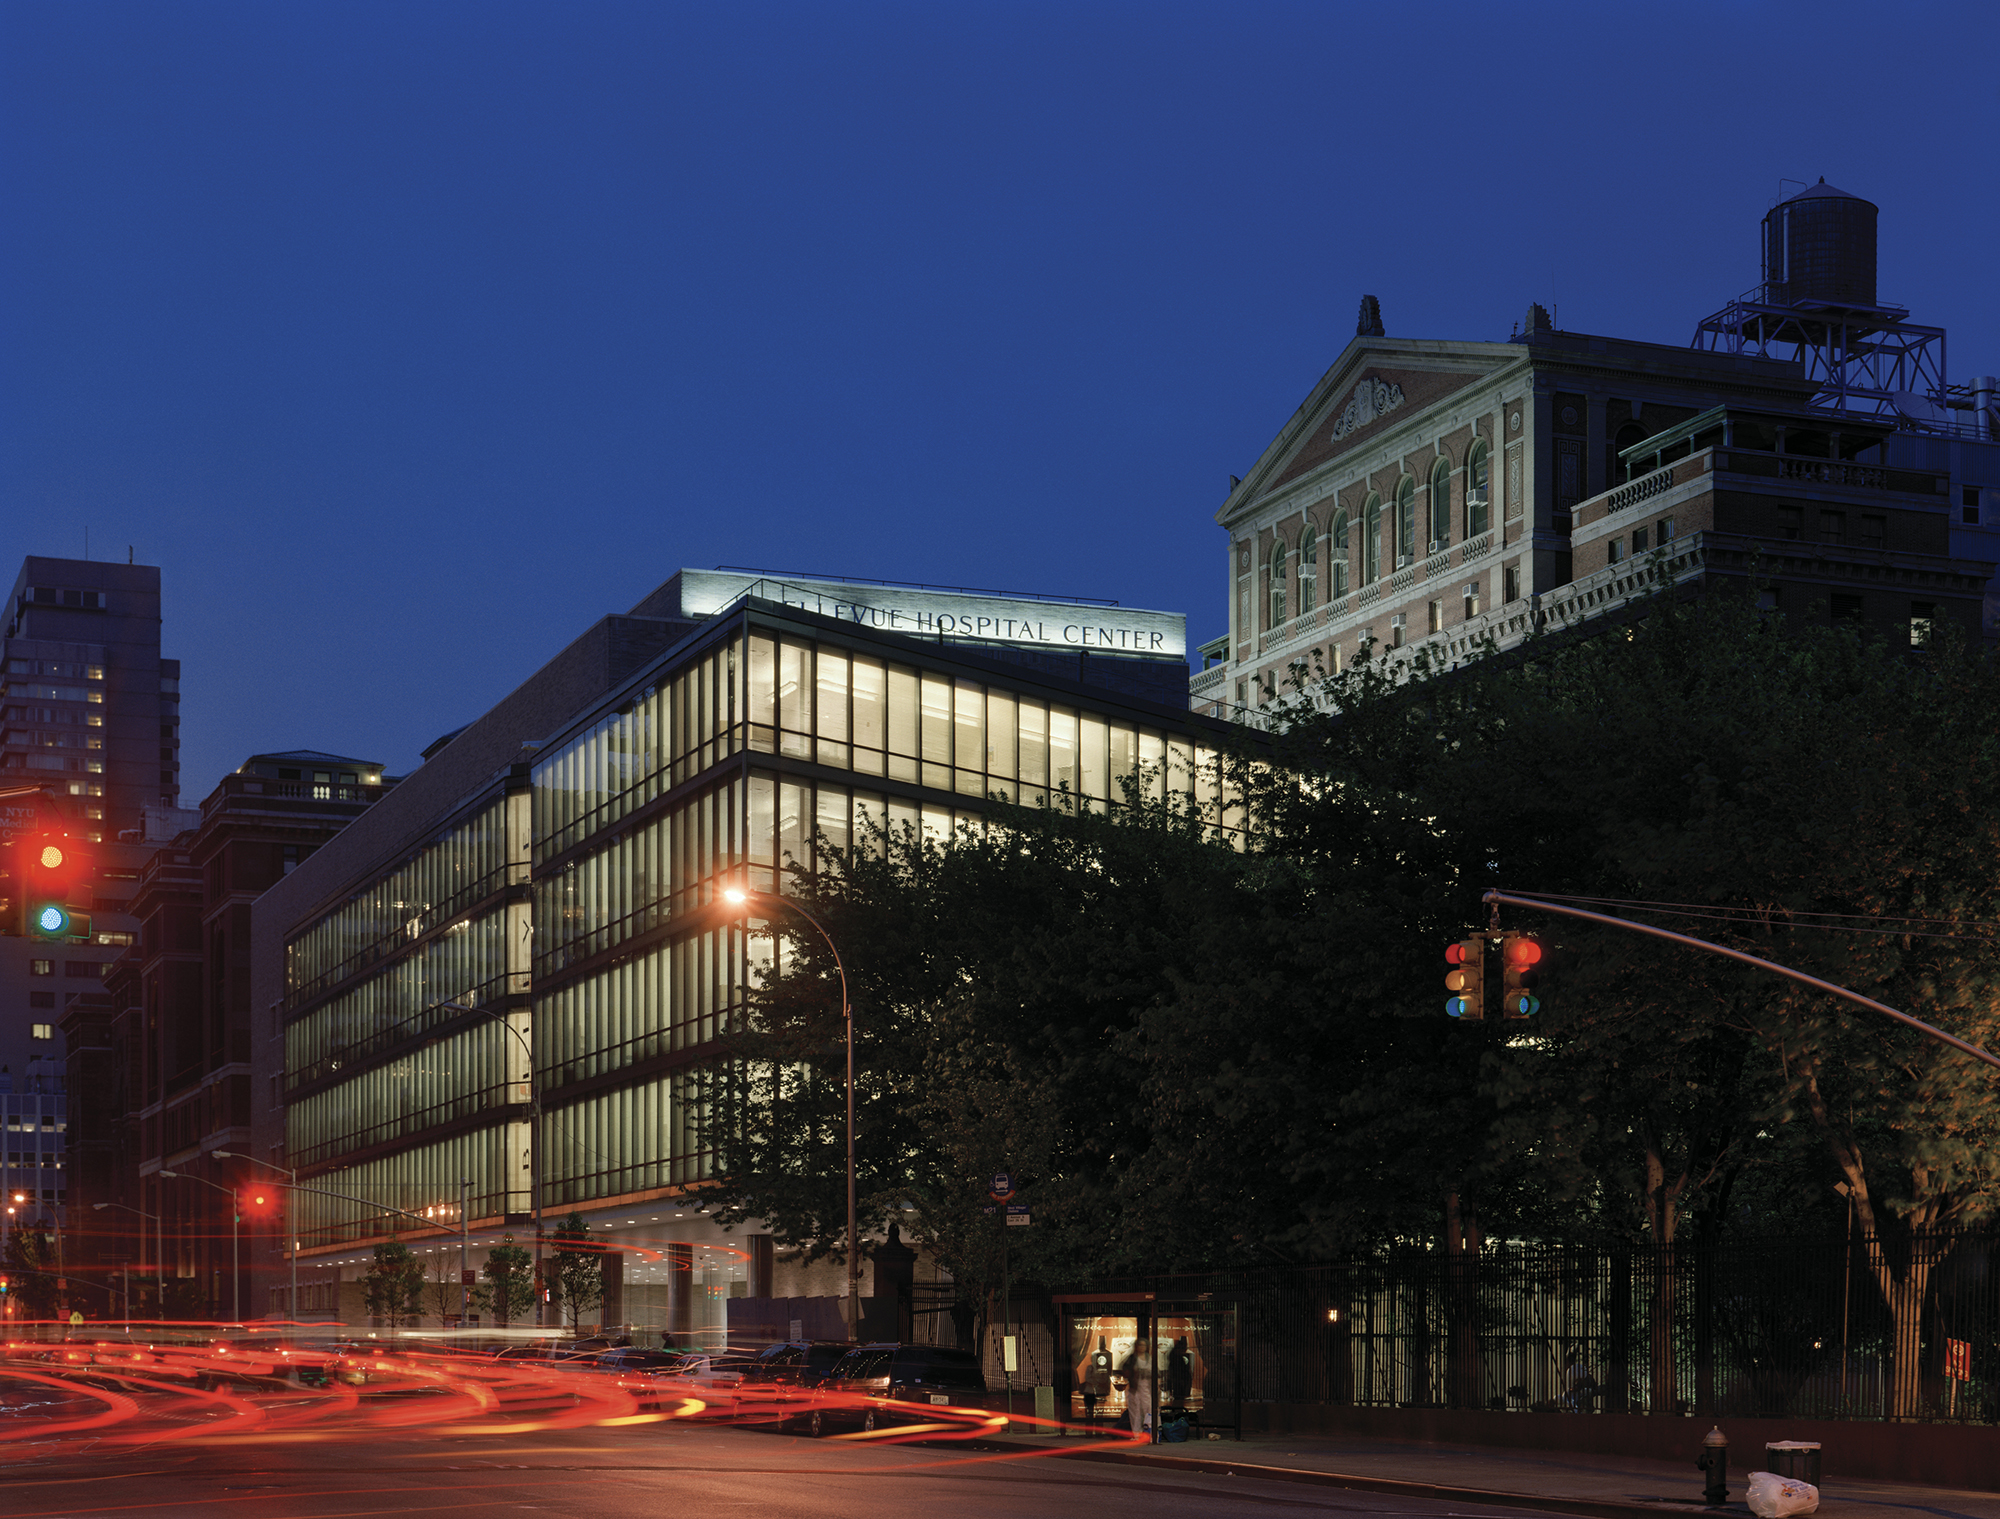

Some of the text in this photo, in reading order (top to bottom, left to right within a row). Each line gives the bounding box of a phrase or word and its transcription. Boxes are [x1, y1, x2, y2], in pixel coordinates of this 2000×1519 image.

[917, 612, 1050, 641] HOSPITAL
[1063, 625, 1163, 650] CENTER
[6, 807, 35, 818] NYU
[983, 1206, 997, 1214] M21
